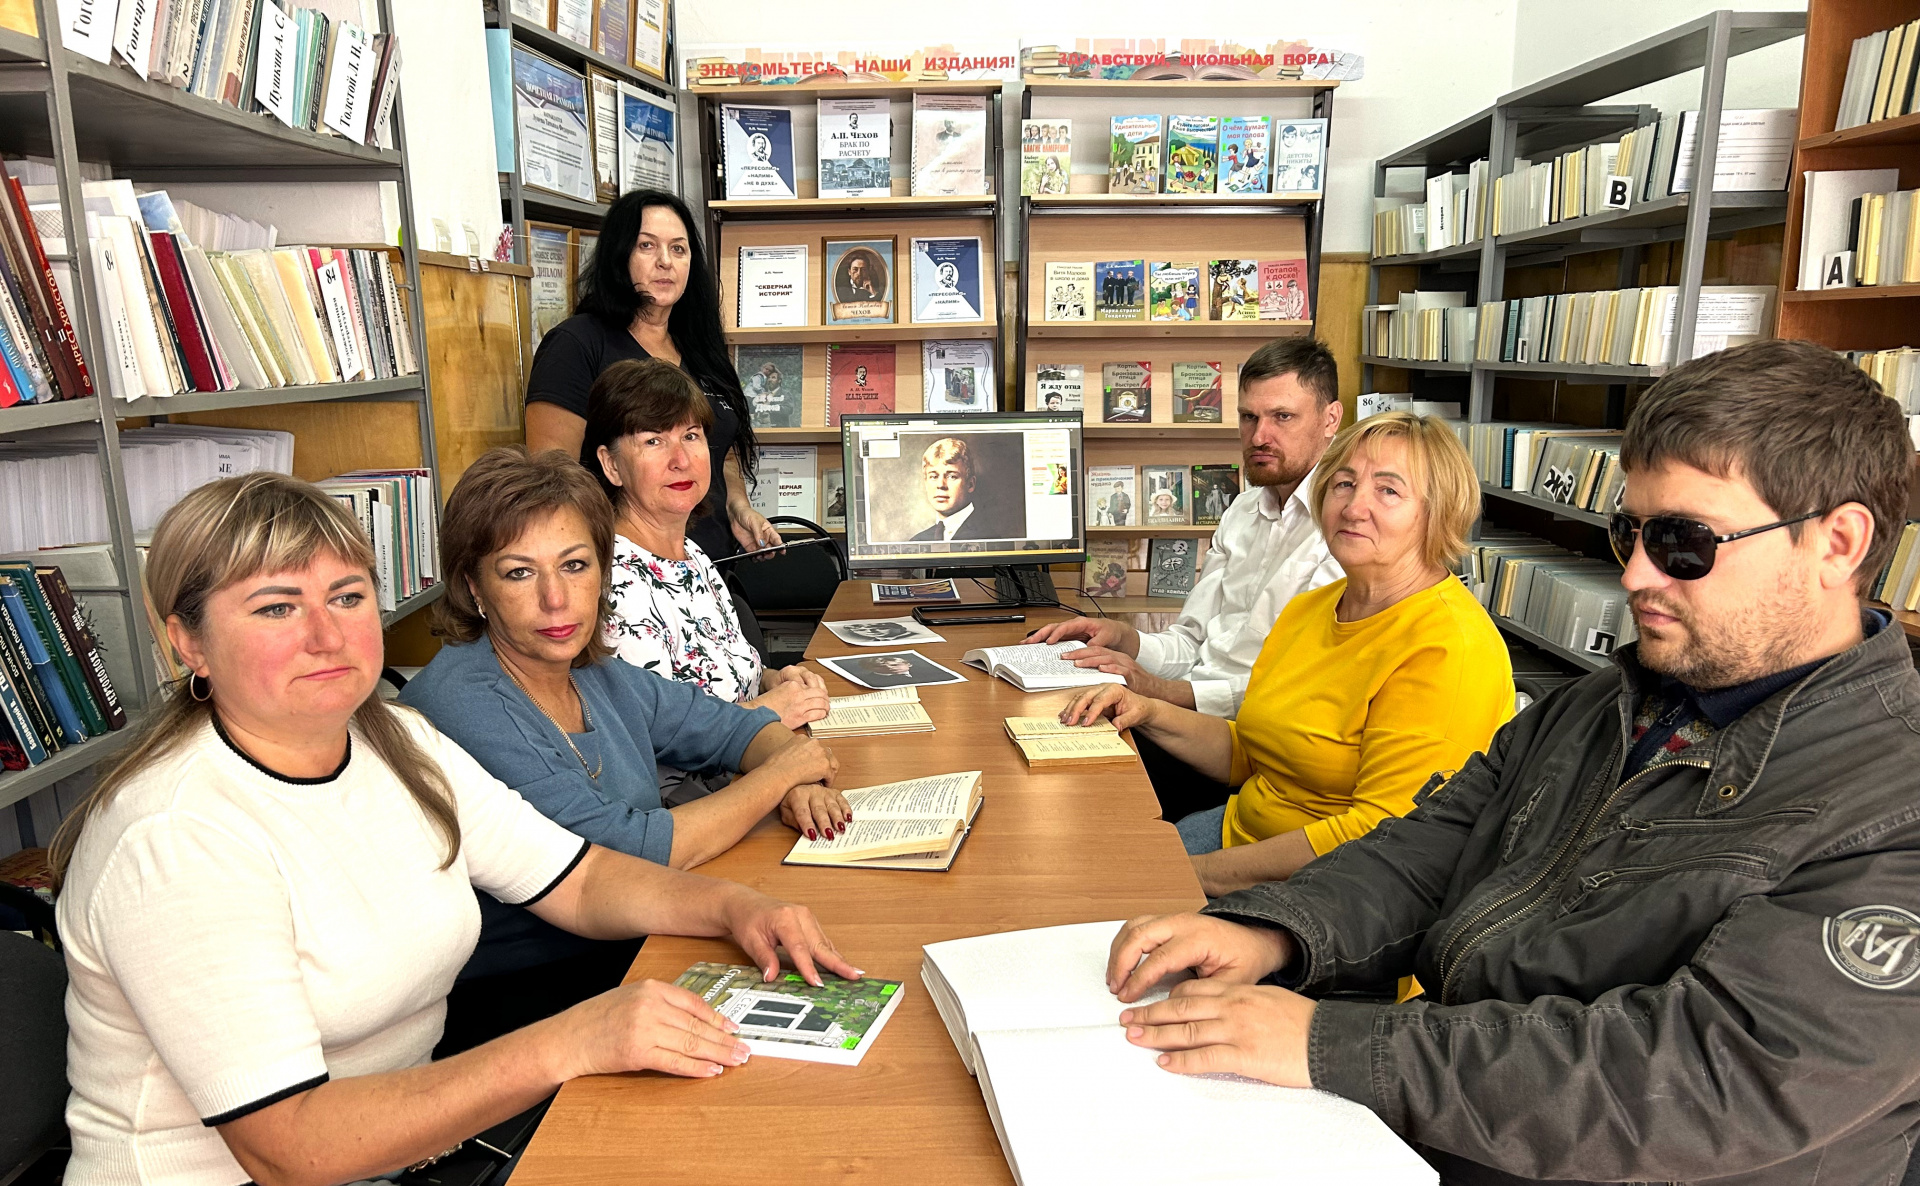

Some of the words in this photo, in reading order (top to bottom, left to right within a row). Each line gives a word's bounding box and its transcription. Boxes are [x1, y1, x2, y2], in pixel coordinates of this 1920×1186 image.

[274, 14, 285, 30] С.
[276, 34, 284, 49] А.
[351, 45, 362, 58] Н.
[182, 63, 190, 78] 2
[350, 58, 360, 77] Л.
[700, 62, 844, 77] ЗНАКОМЬТЕСЬ,
[854, 59, 911, 73] НАШИ
[924, 56, 1015, 71] ИЗДАНИЯ!
[1058, 53, 1170, 68] ЗДРАВСТВУЙ,
[1180, 54, 1274, 66] ШКОЛЬНАЯ
[1283, 53, 1336, 66] ПОРА!
[269, 49, 283, 108] Пушкин
[340, 75, 358, 128] Толстой
[1610, 180, 1627, 207] В
[326, 268, 337, 284] 84
[536, 266, 562, 278] ДИПЛОМ
[1264, 266, 1299, 274] Потапов,
[1273, 272, 1298, 280] доске!
[1826, 257, 1844, 285] А
[46, 268, 71, 327] ХРИСТОВ
[66, 328, 84, 366] КРЕСТ
[1362, 397, 1373, 406] 86
[1544, 468, 1564, 493] Ж
[1563, 475, 1572, 496] З
[50, 611, 74, 656] ЛАБИРИНТЫ
[1590, 631, 1614, 653] Л
[88, 648, 118, 707] ЧЕРТОПОЛОХЕ
[15, 710, 37, 750] Бахревский
